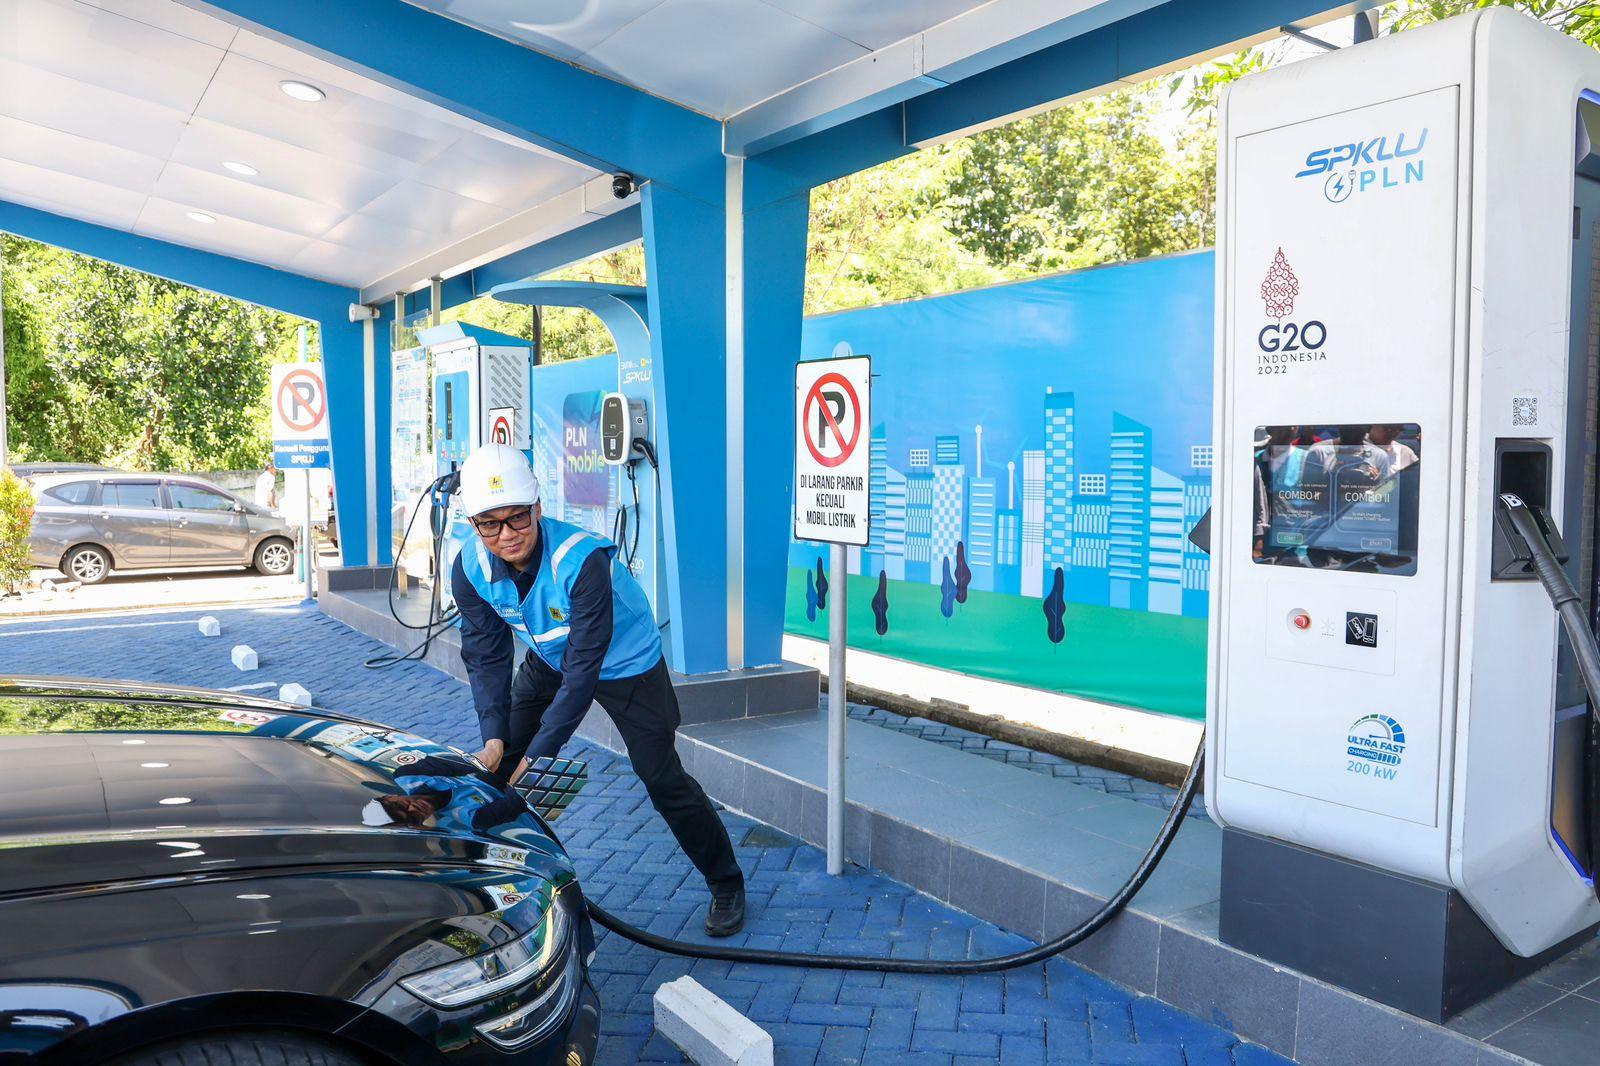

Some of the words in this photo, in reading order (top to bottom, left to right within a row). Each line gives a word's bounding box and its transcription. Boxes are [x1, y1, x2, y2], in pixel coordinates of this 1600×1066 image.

[1295, 128, 1428, 178] SPKLU
[1360, 160, 1424, 191] PLN
[1258, 320, 1327, 353] G20
[1257, 352, 1327, 364] INDONESIA
[1258, 365, 1287, 375] 2022
[565, 427, 587, 447] PLN
[566, 450, 606, 473] mobile
[801, 475, 808, 488] DI
[808, 475, 836, 490] LARANG
[837, 476, 864, 491] PARKIR
[816, 493, 845, 509] KECUALI
[1278, 490, 1313, 501] COMBO
[1344, 492, 1382, 503] COMBO
[1384, 493, 1390, 503] II
[806, 511, 827, 526] MOBIL
[828, 513, 856, 529] LISTRIK
[1347, 735, 1378, 748] ULTRA
[1380, 742, 1406, 754] FAST
[1347, 760, 1370, 775] 200
[1374, 766, 1398, 781] kW
